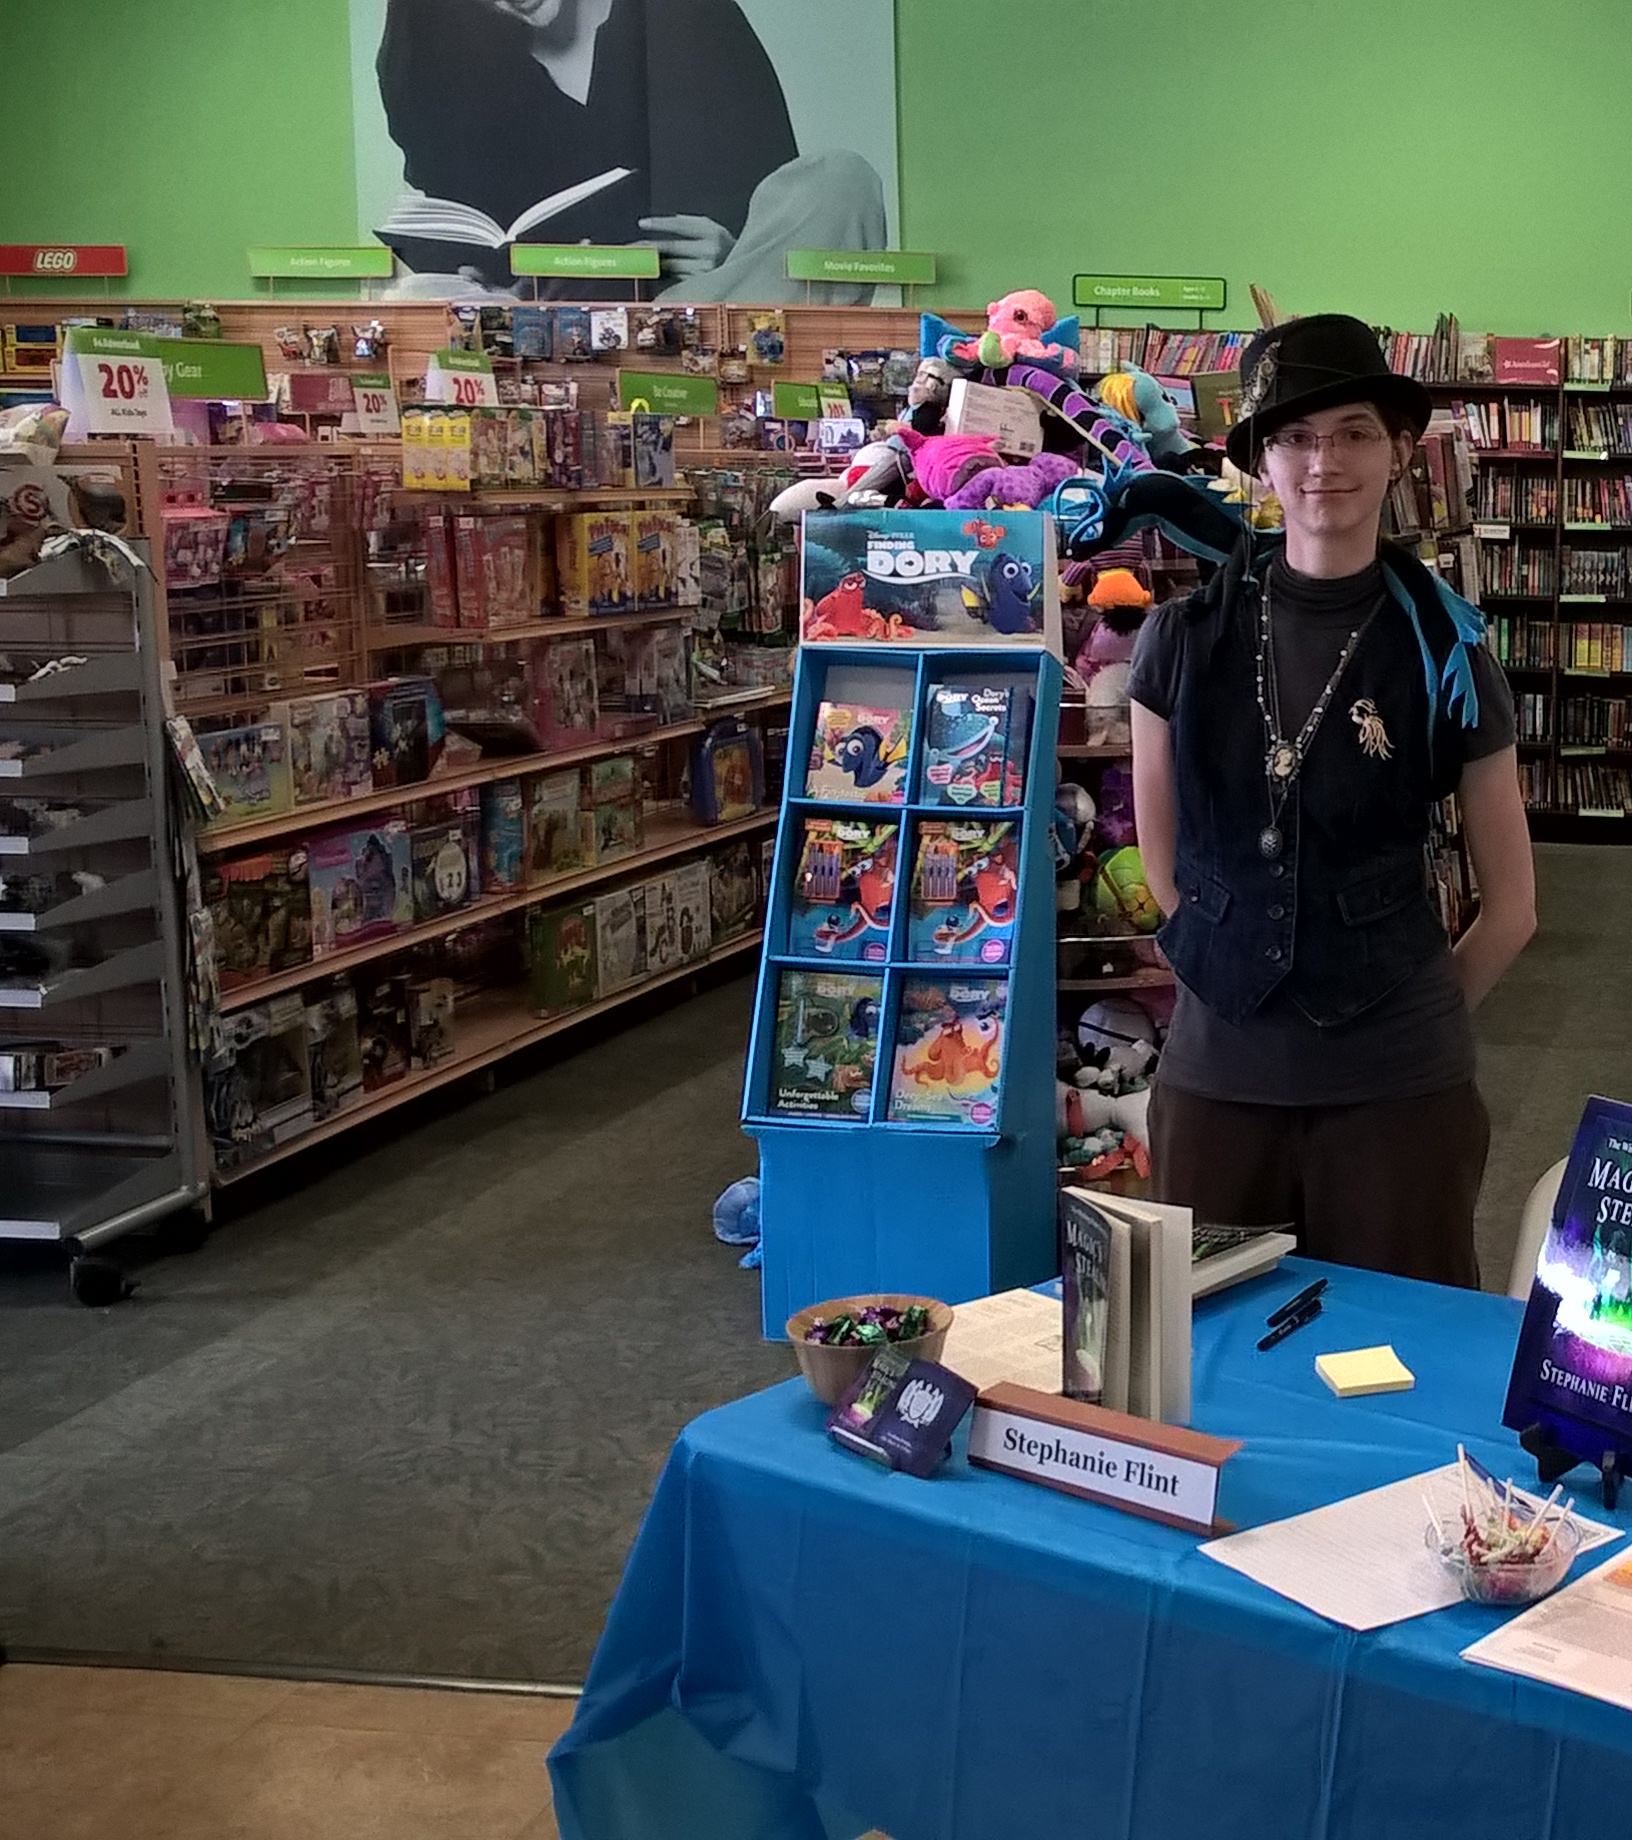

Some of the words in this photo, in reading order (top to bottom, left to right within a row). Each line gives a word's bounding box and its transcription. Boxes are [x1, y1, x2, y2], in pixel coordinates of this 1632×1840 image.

[36, 251, 75, 269] LEGO
[290, 257, 318, 267] Action
[320, 257, 350, 268] Figures
[554, 256, 583, 267] Action
[585, 257, 616, 269] Figures
[824, 260, 852, 271] Movie
[854, 261, 895, 273] Favorites
[1094, 284, 1130, 299] Chapter
[1132, 285, 1160, 297] Books
[176, 362, 202, 378] Gear
[98, 363, 149, 399] 20%
[453, 377, 486, 405] 20%
[363, 392, 388, 414] 20%
[867, 540, 915, 551] FINDING
[867, 550, 980, 578] DORY
[937, 692, 969, 703] DORY
[975, 703, 1007, 713] Secrets
[837, 825, 872, 840] DORY
[778, 1087, 840, 1103] Unforgettable
[777, 1099, 819, 1110] Activities
[1608, 1137, 1622, 1150] The
[1540, 1359, 1610, 1404] STEPHANIE
[1003, 1427, 1118, 1480] Stephanie
[1123, 1459, 1181, 1497] Flint
